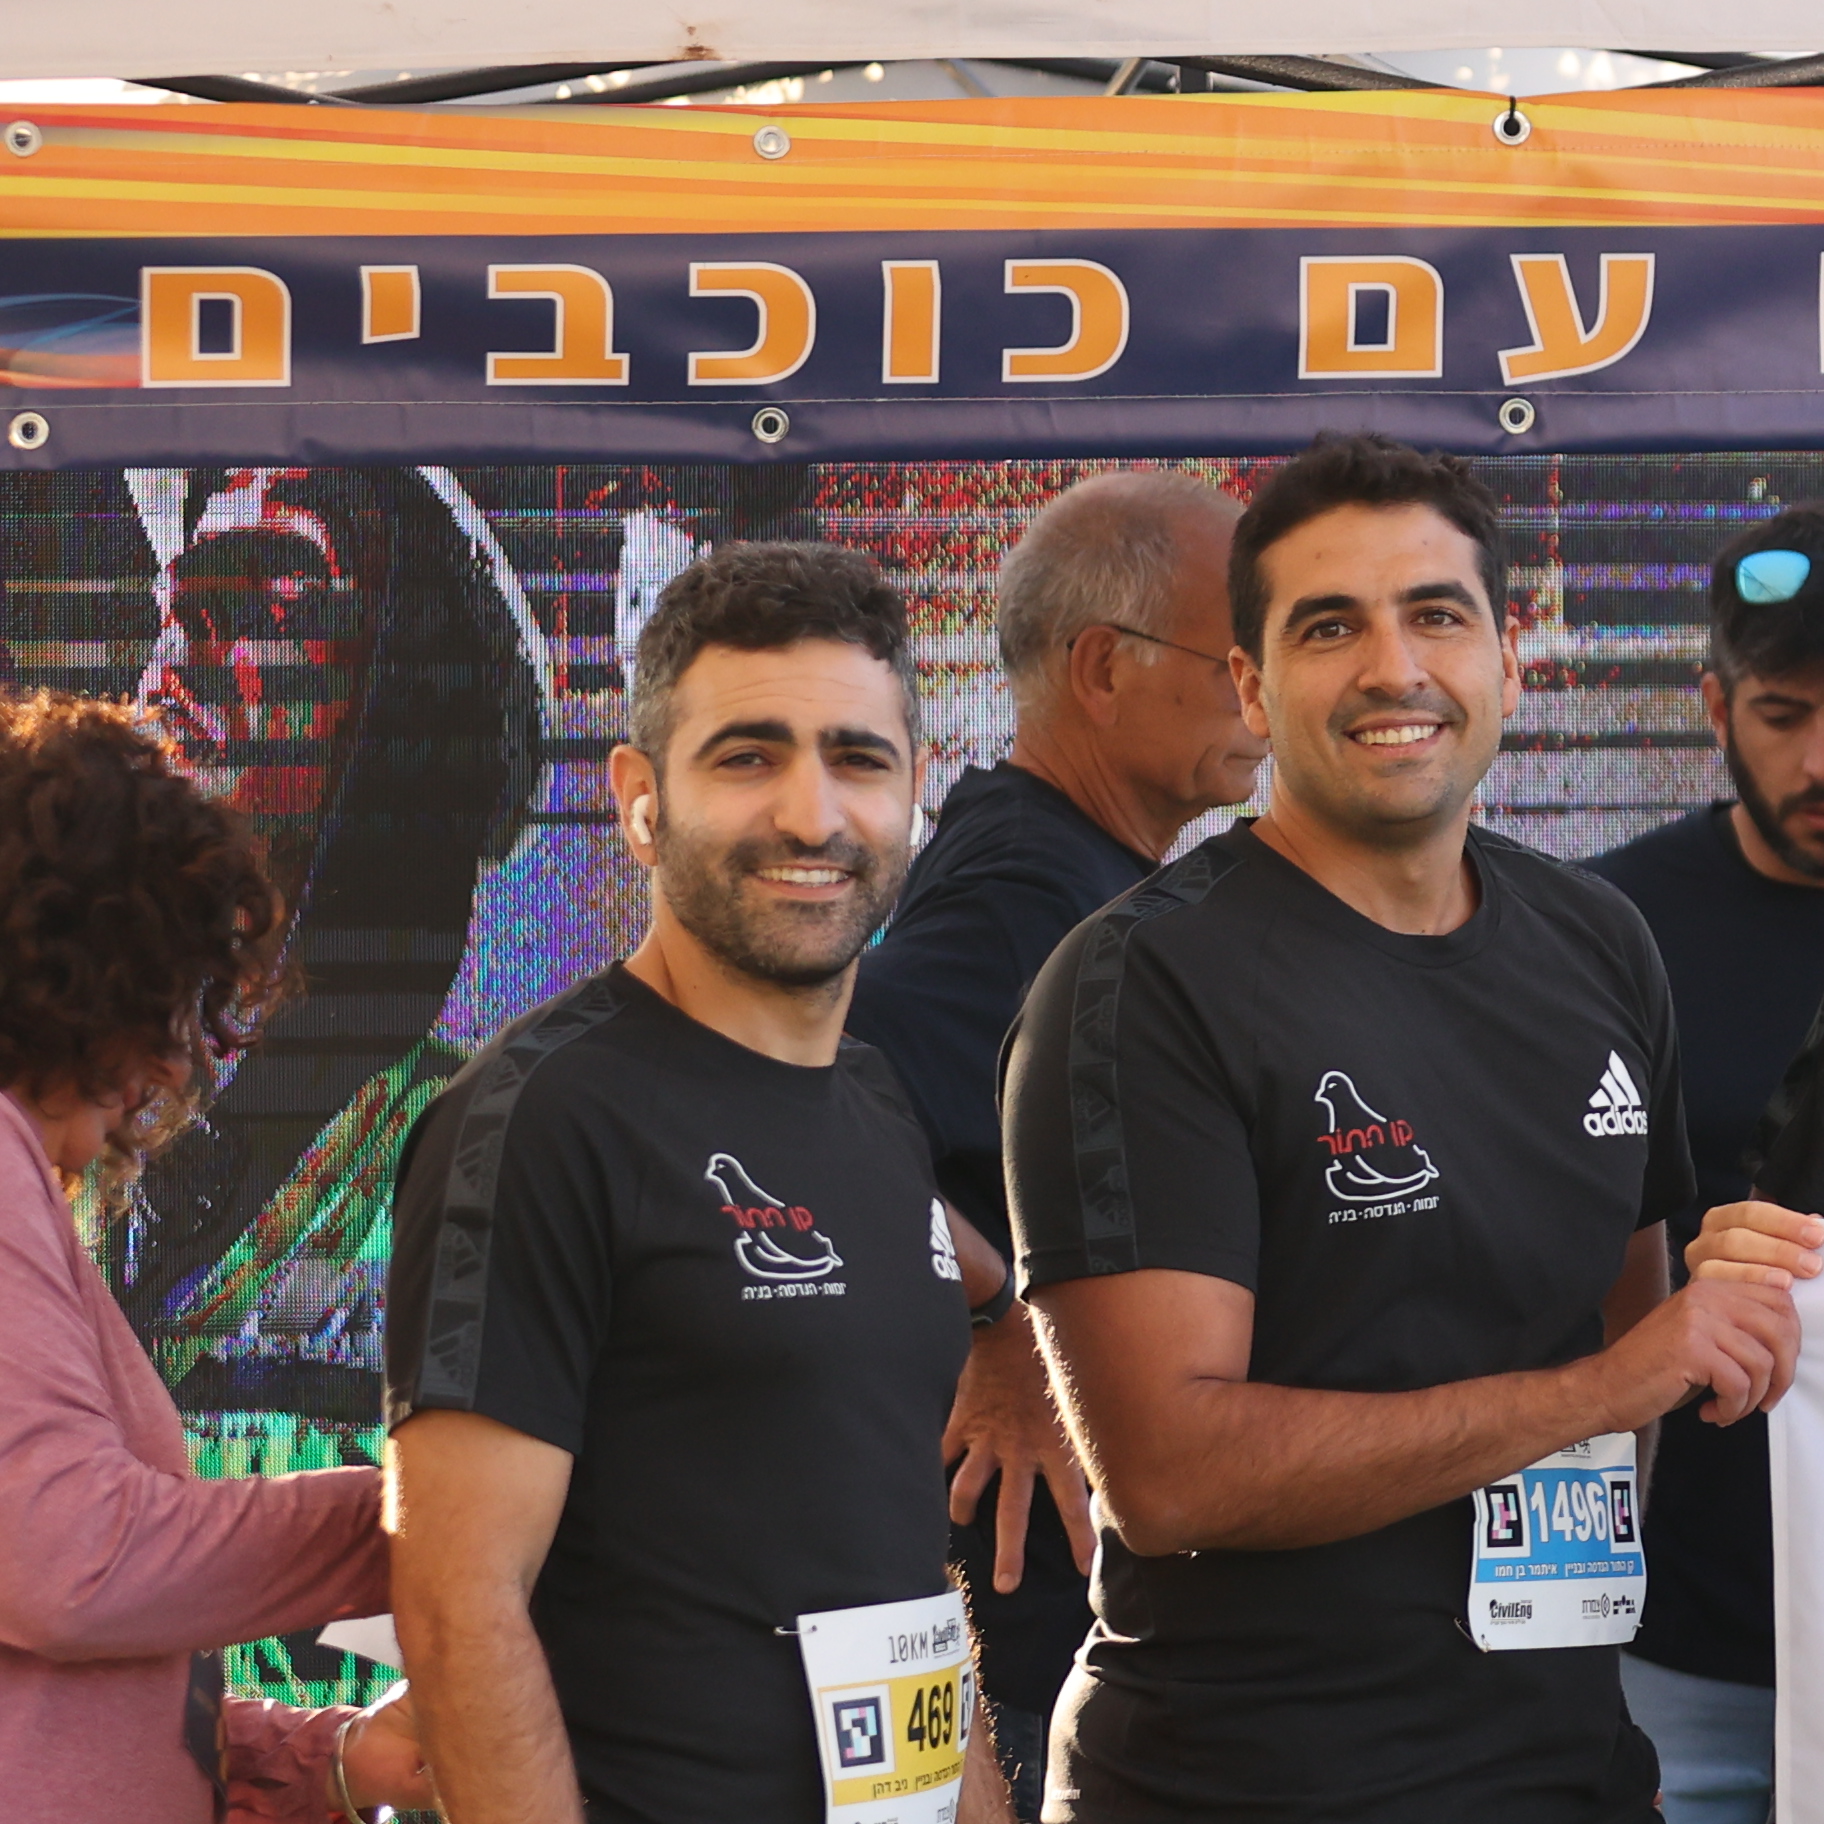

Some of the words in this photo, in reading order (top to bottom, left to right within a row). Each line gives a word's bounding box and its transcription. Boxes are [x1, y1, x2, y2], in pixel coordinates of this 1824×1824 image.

[139, 257, 1131, 388] כוכבים
[1297, 250, 1656, 387] עם
[1582, 1104, 1649, 1138] adidas
[1530, 1480, 1608, 1543] 1496
[888, 1630, 929, 1664] 10KM
[906, 1680, 954, 1753] 469
